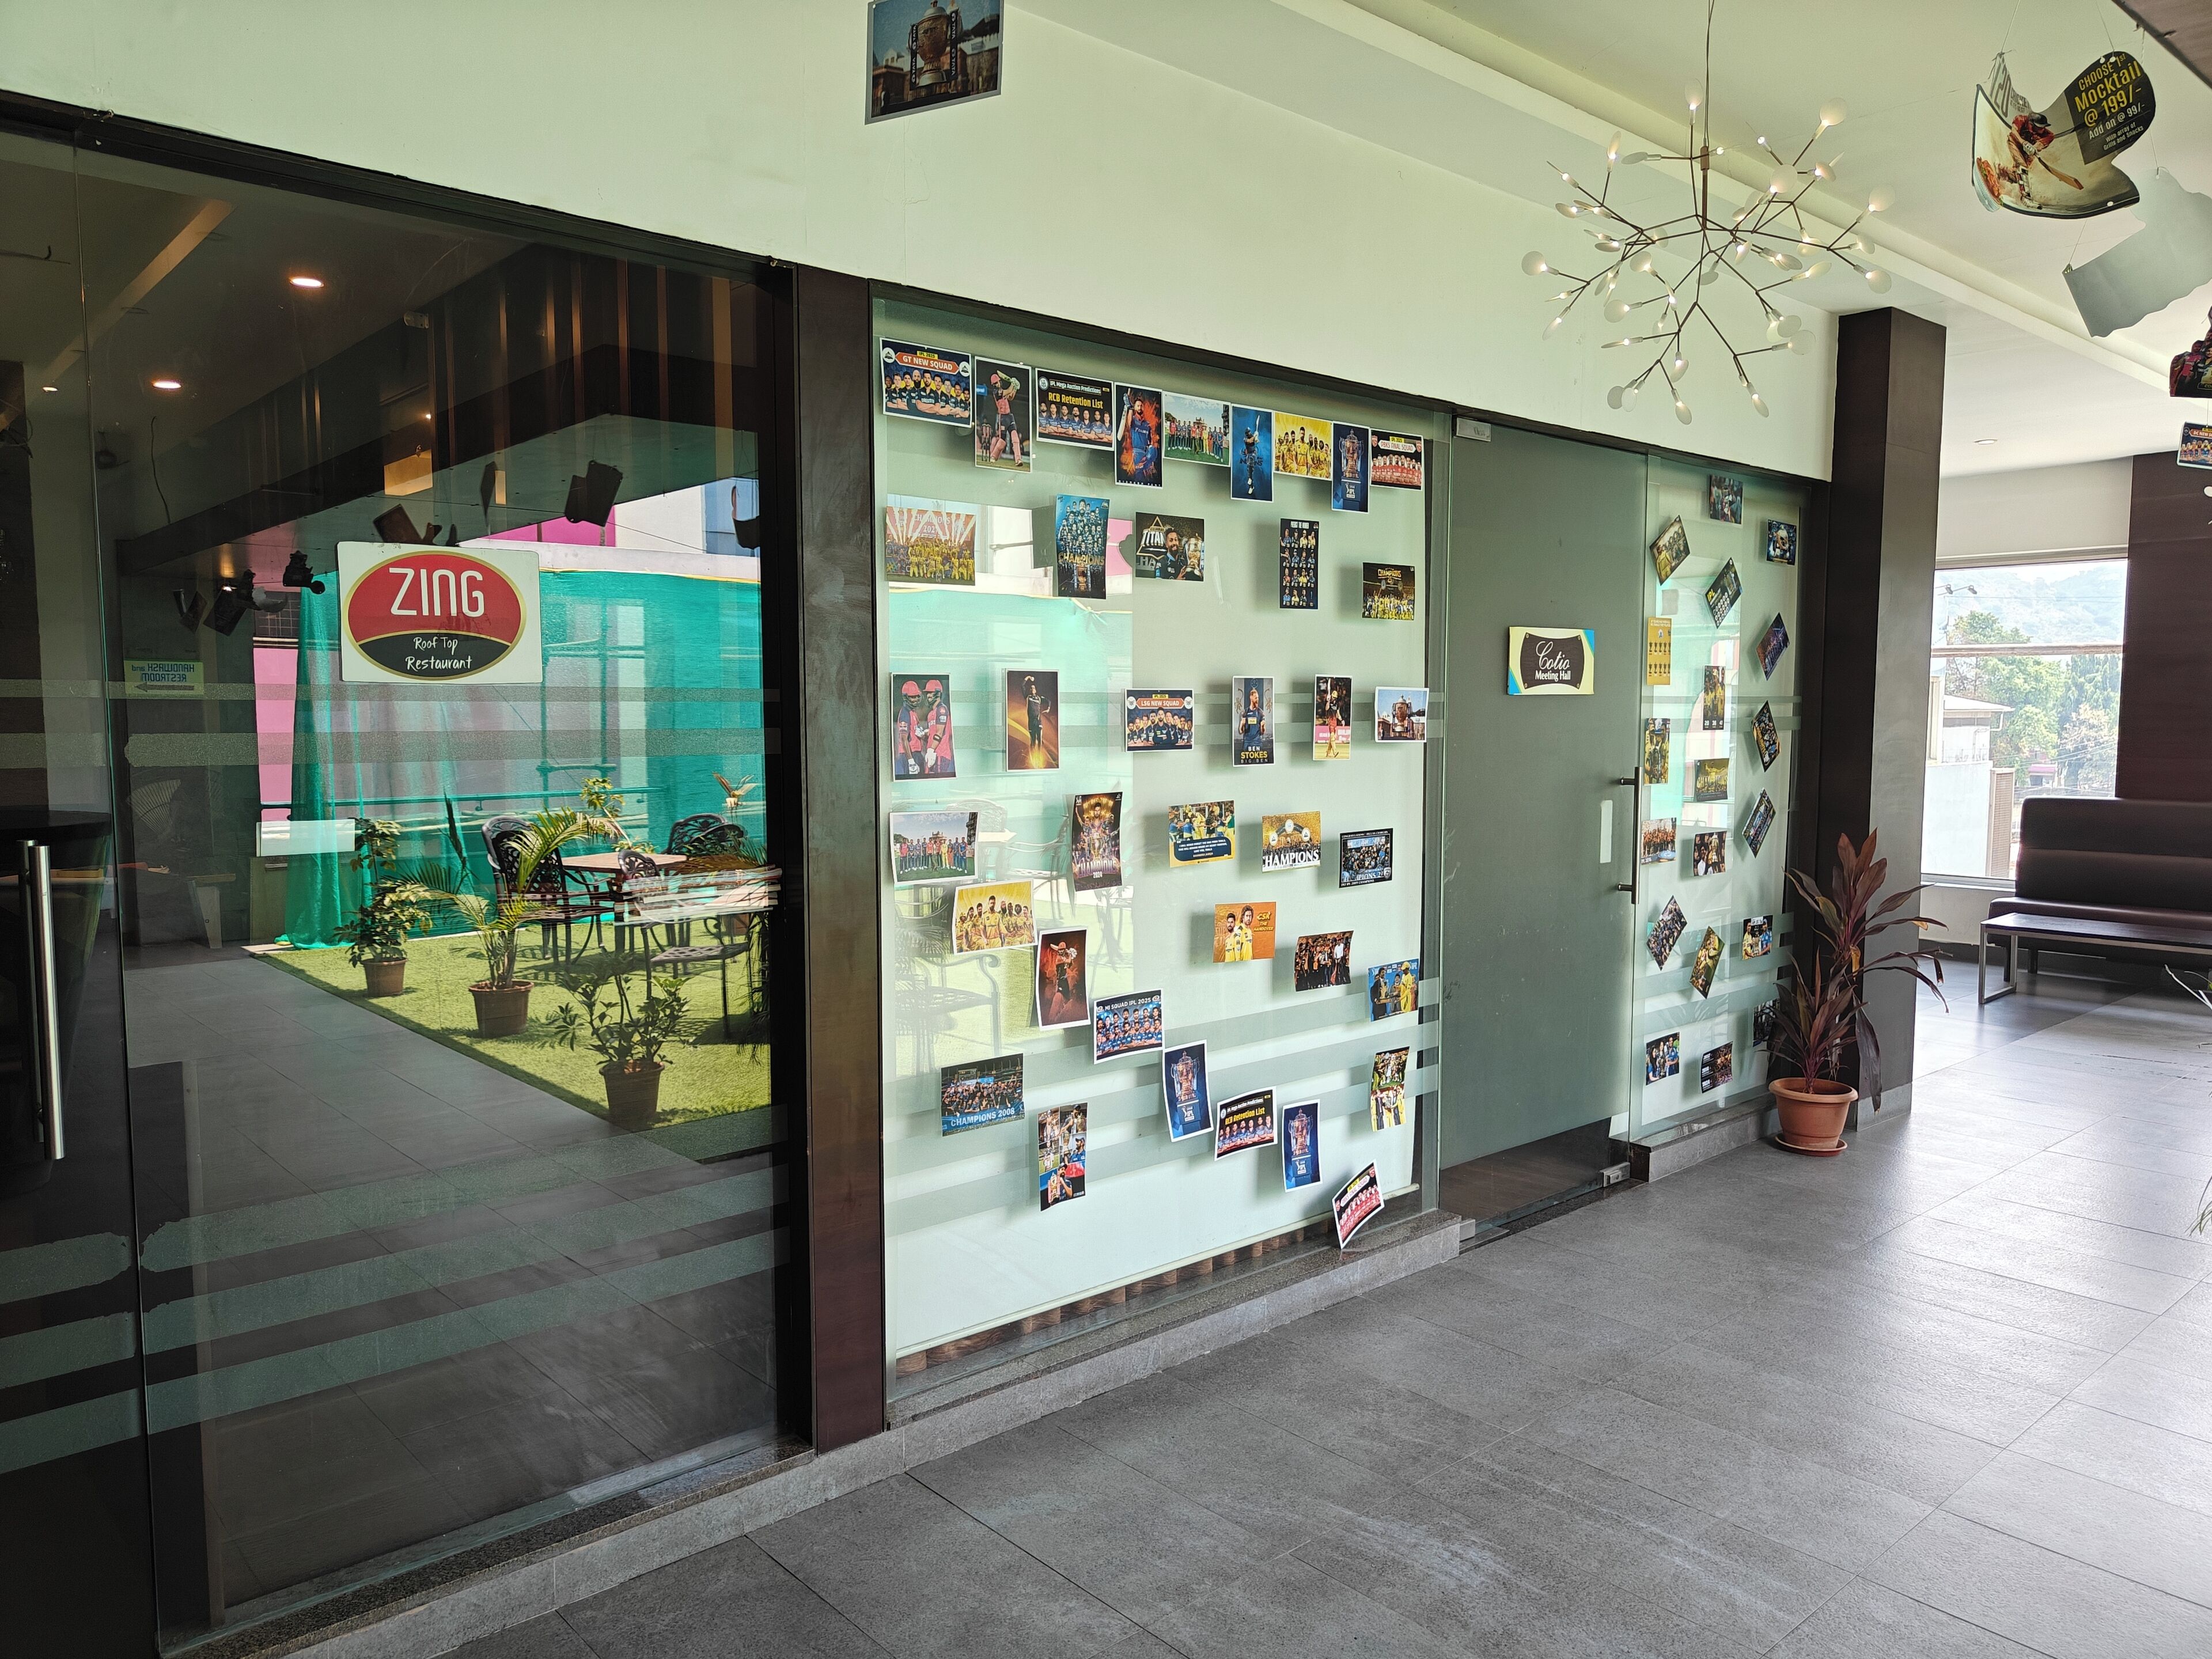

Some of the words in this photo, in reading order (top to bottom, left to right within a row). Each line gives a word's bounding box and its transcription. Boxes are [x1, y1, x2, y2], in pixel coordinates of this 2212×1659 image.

[2078, 62, 2115, 90] CHOOSE
[2084, 108, 2098, 127] @
[2101, 85, 2142, 116] 199/-
[2089, 124, 2104, 140] Add
[2105, 117, 2116, 130] on
[2117, 112, 2126, 122] @
[2127, 102, 2145, 116] 99/-
[2103, 141, 2116, 150] Grills
[2117, 135, 2126, 144] and
[2126, 125, 2144, 138] Snacks
[2105, 133, 2116, 143] With
[2118, 126, 2130, 136] array
[903, 355, 912, 363] GT
[913, 357, 929, 366] NEW
[930, 360, 953, 370] SQUAD
[1081, 385, 1101, 394] Predictions
[1048, 392, 1060, 402] RCB
[1062, 394, 1092, 407] Retention
[1092, 399, 1104, 409] List
[1058, 551, 1105, 566] CHAMPIONS
[1378, 569, 1402, 577] CHAMPIONS
[389, 567, 484, 617] ZING
[414, 637, 438, 651] Roof
[440, 637, 458, 656] Top
[405, 656, 473, 672] Restaurant
[1535, 670, 1559, 682] Meeting
[1559, 670, 1571, 680] Hall
[1241, 751, 1268, 759] STOKES
[1077, 859, 1118, 878] CHAMPIONS
[1256, 912, 1272, 921] CSK
[1111, 1001, 1128, 1009] SQUAD
[950, 1111, 997, 1127] CHAMPIONS
[998, 1107, 1015, 1117] 2008
[1225, 1116, 1233, 1126] RCB
[1233, 1109, 1255, 1122] Retention
[1256, 1107, 1266, 1116] List
